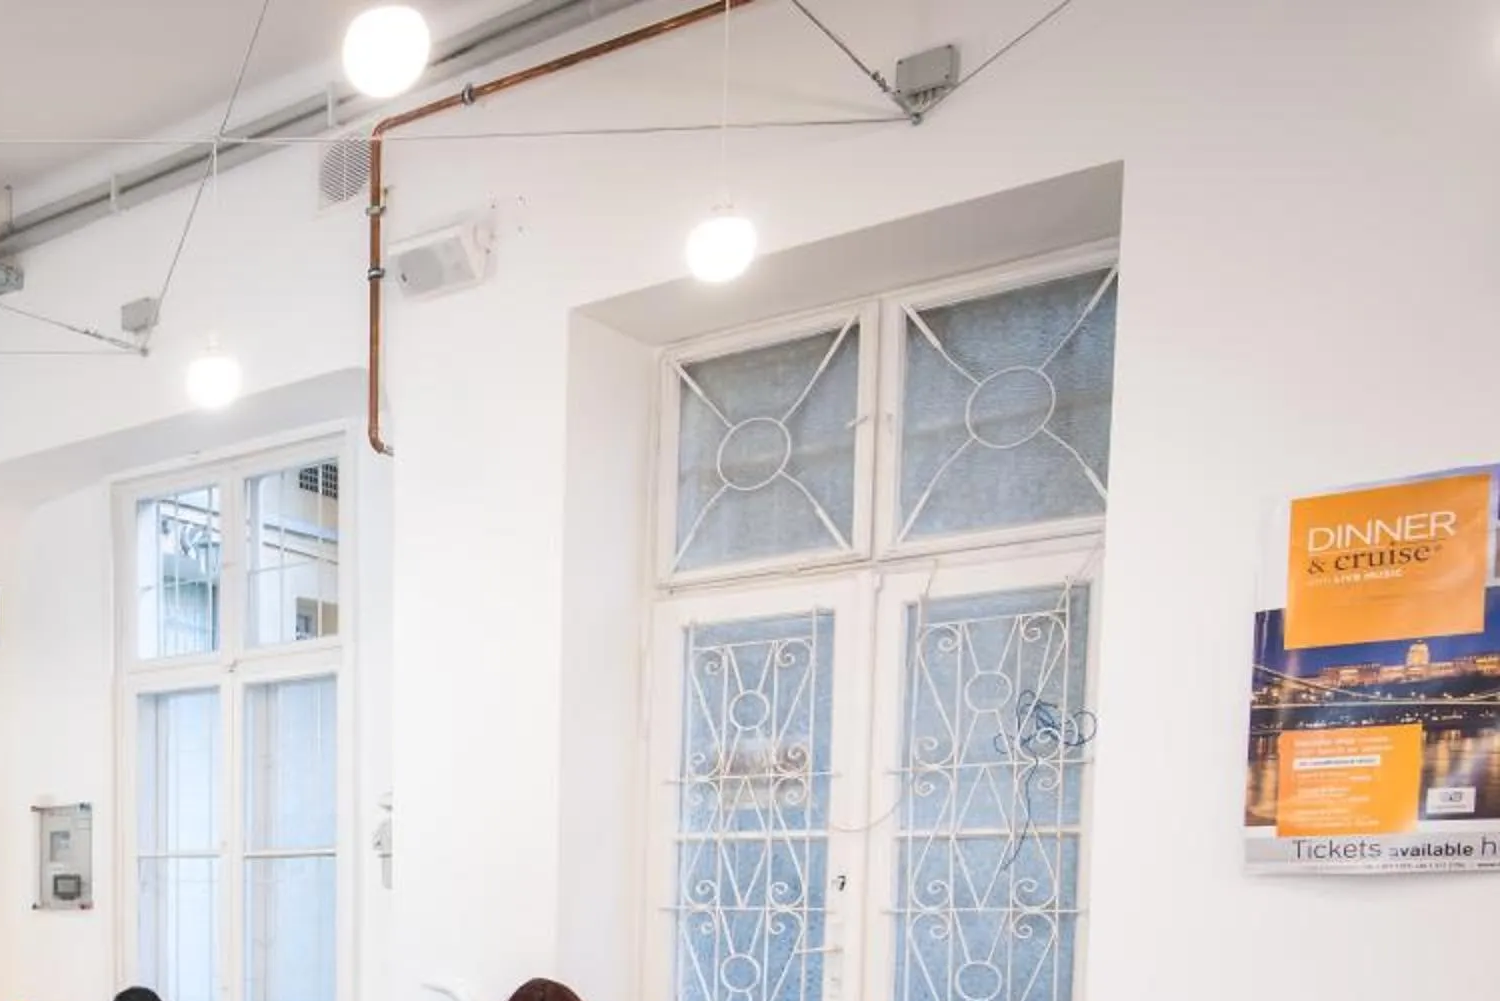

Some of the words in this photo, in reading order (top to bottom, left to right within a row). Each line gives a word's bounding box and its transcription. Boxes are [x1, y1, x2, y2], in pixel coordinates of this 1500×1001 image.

[1307, 511, 1457, 553] DINNER
[1334, 540, 1430, 571] cruise
[1291, 838, 1383, 860] Tickets
[1387, 843, 1475, 859] available
